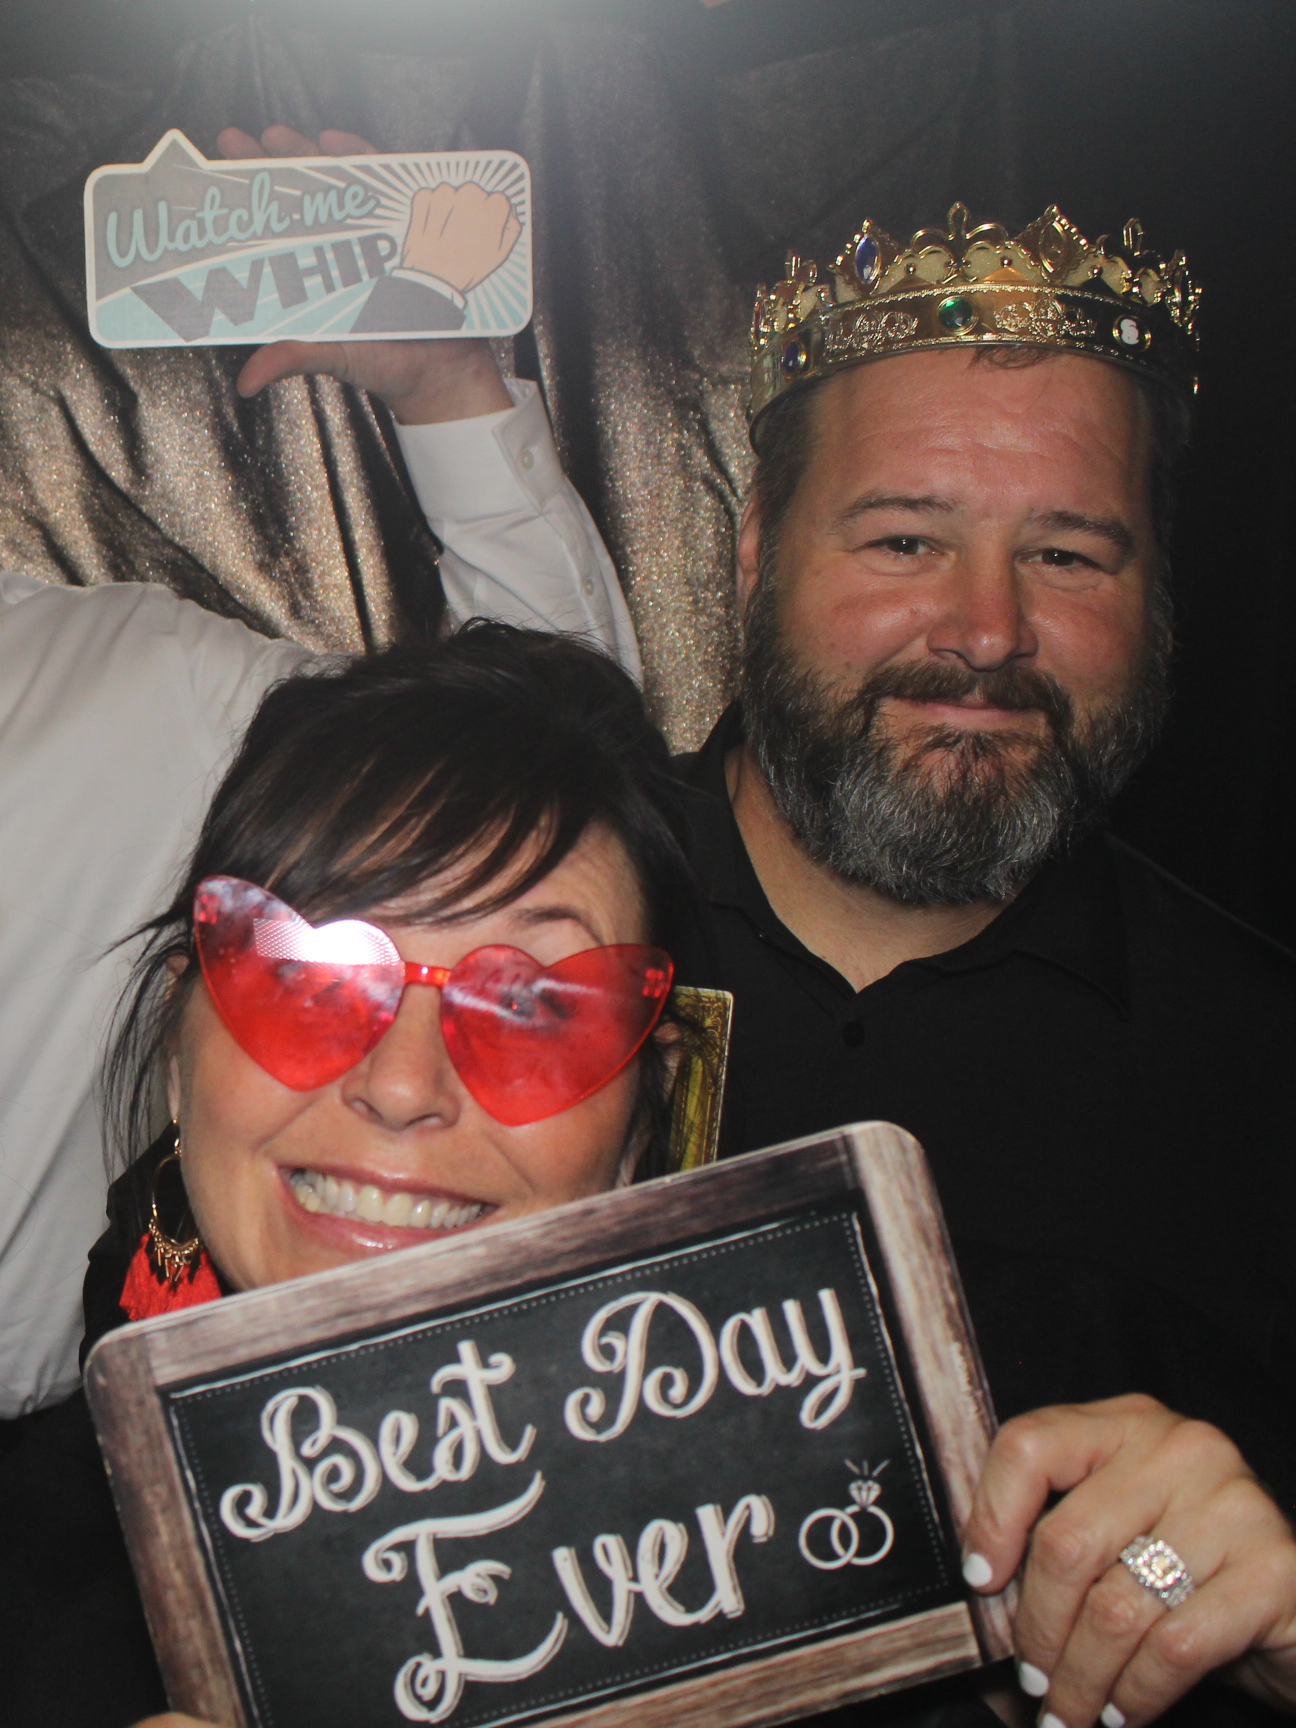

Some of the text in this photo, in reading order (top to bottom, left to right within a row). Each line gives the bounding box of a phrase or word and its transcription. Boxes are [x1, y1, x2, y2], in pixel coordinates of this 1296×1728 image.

[106, 172, 377, 268] Watch me
[130, 232, 398, 342] WHIP
[219, 1288, 867, 1541] Best Day
[362, 1471, 774, 1723] Ever
